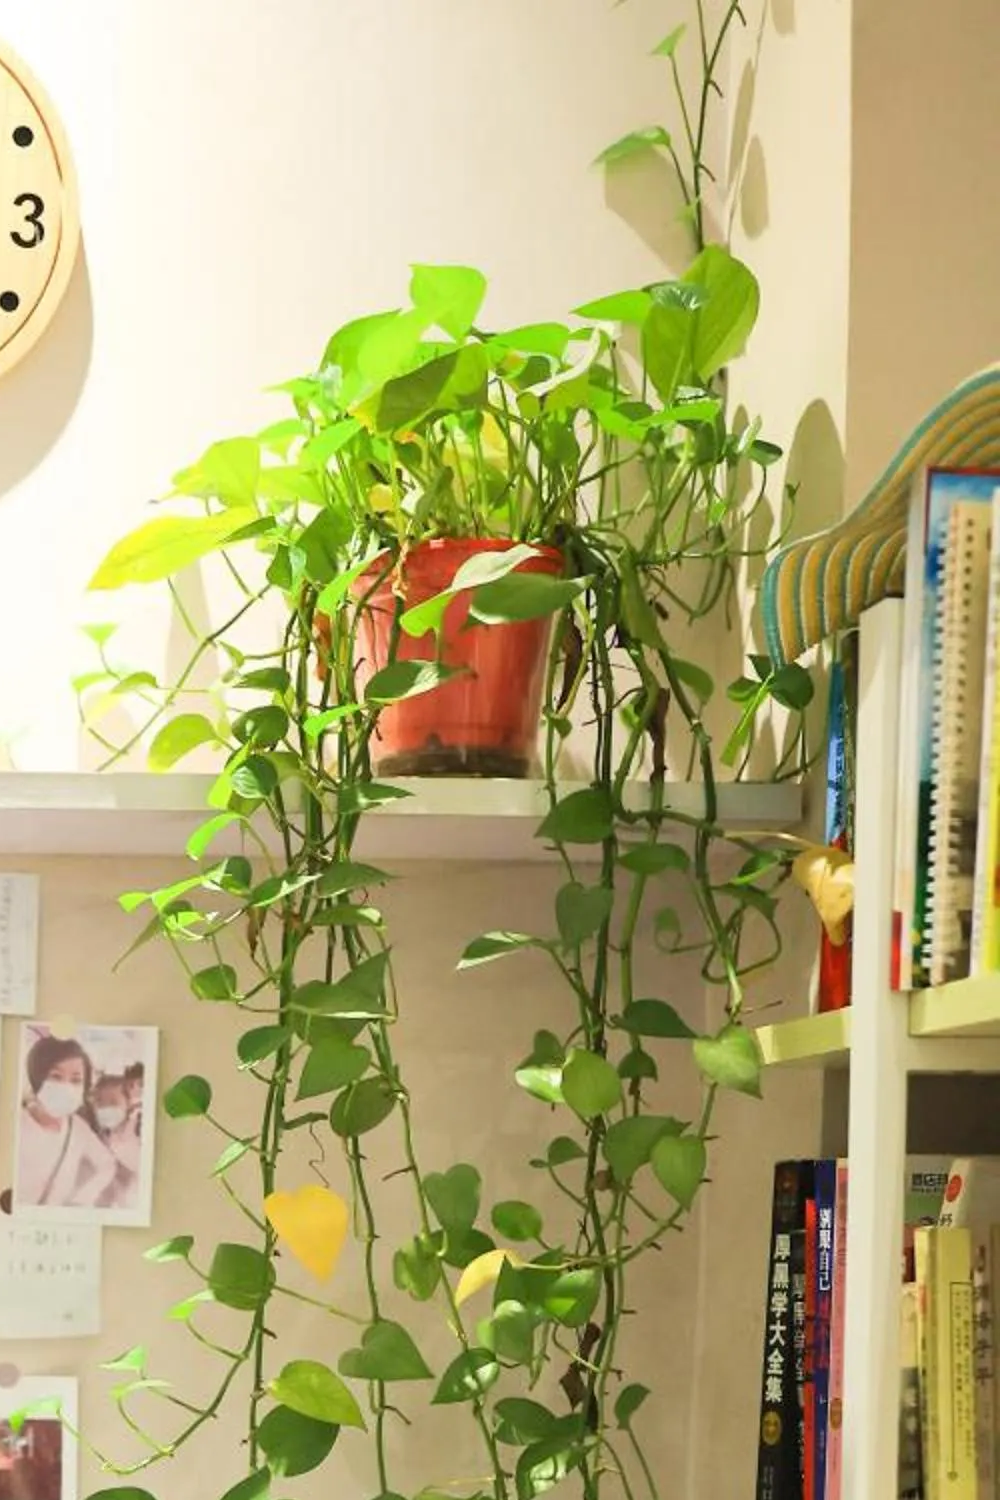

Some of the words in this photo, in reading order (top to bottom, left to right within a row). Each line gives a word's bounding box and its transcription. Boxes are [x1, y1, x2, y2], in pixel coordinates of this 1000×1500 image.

[9, 192, 46, 249] 3
[764, 1233, 791, 1403] 厚黑学大全集
